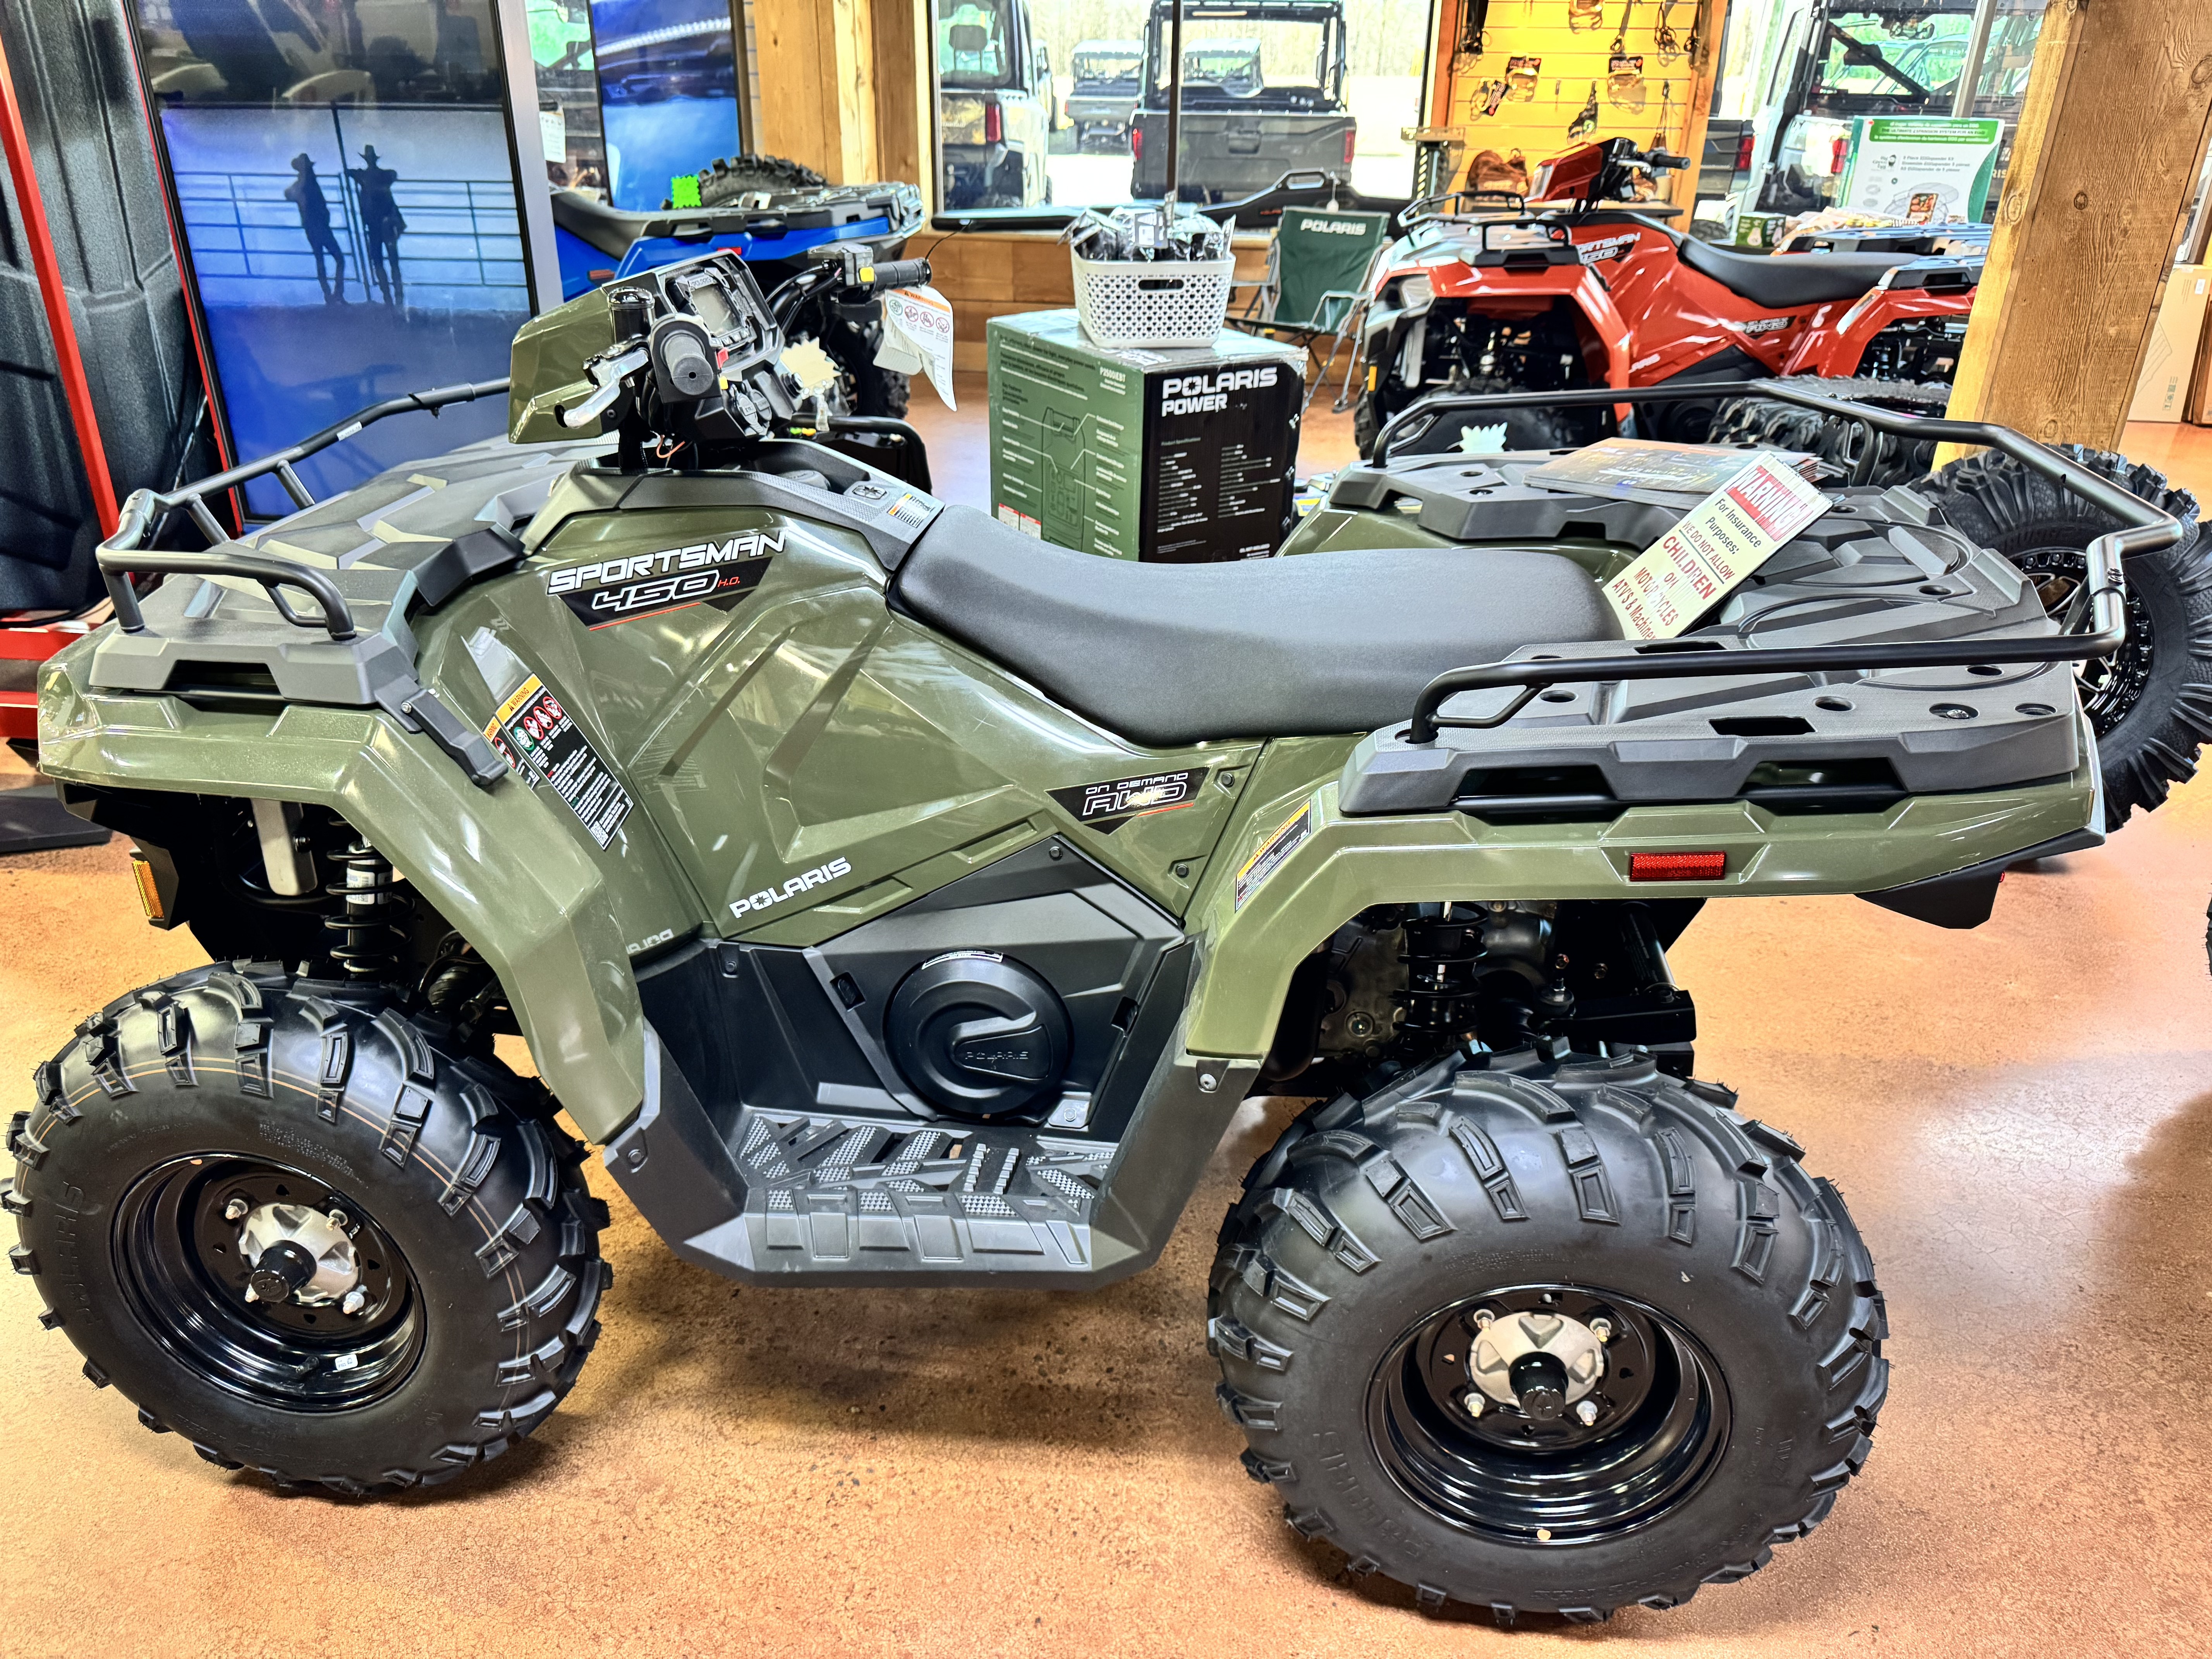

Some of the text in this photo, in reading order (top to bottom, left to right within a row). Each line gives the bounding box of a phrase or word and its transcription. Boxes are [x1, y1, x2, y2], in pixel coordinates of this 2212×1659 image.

[1300, 218, 1367, 236] POLARIS
[1162, 366, 1278, 399] POLARIS
[1162, 393, 1228, 417] POWER
[1705, 516, 1740, 555] Purposes:
[1715, 498, 1762, 548] For Insurance
[547, 533, 786, 595] SPORTSMAN
[1682, 520, 1735, 580] WE DO NOT ALLOW
[1663, 536, 1717, 600] CHILDREN
[592, 569, 741, 612] 450 H.O.
[1625, 598, 1638, 611] &
[511, 687, 529, 707] WARNING
[1082, 781, 1187, 816] AWD
[1086, 773, 1188, 795] ON DEMAND
[1260, 821, 1291, 853] WARNING
[729, 856, 852, 919] POLARIS
